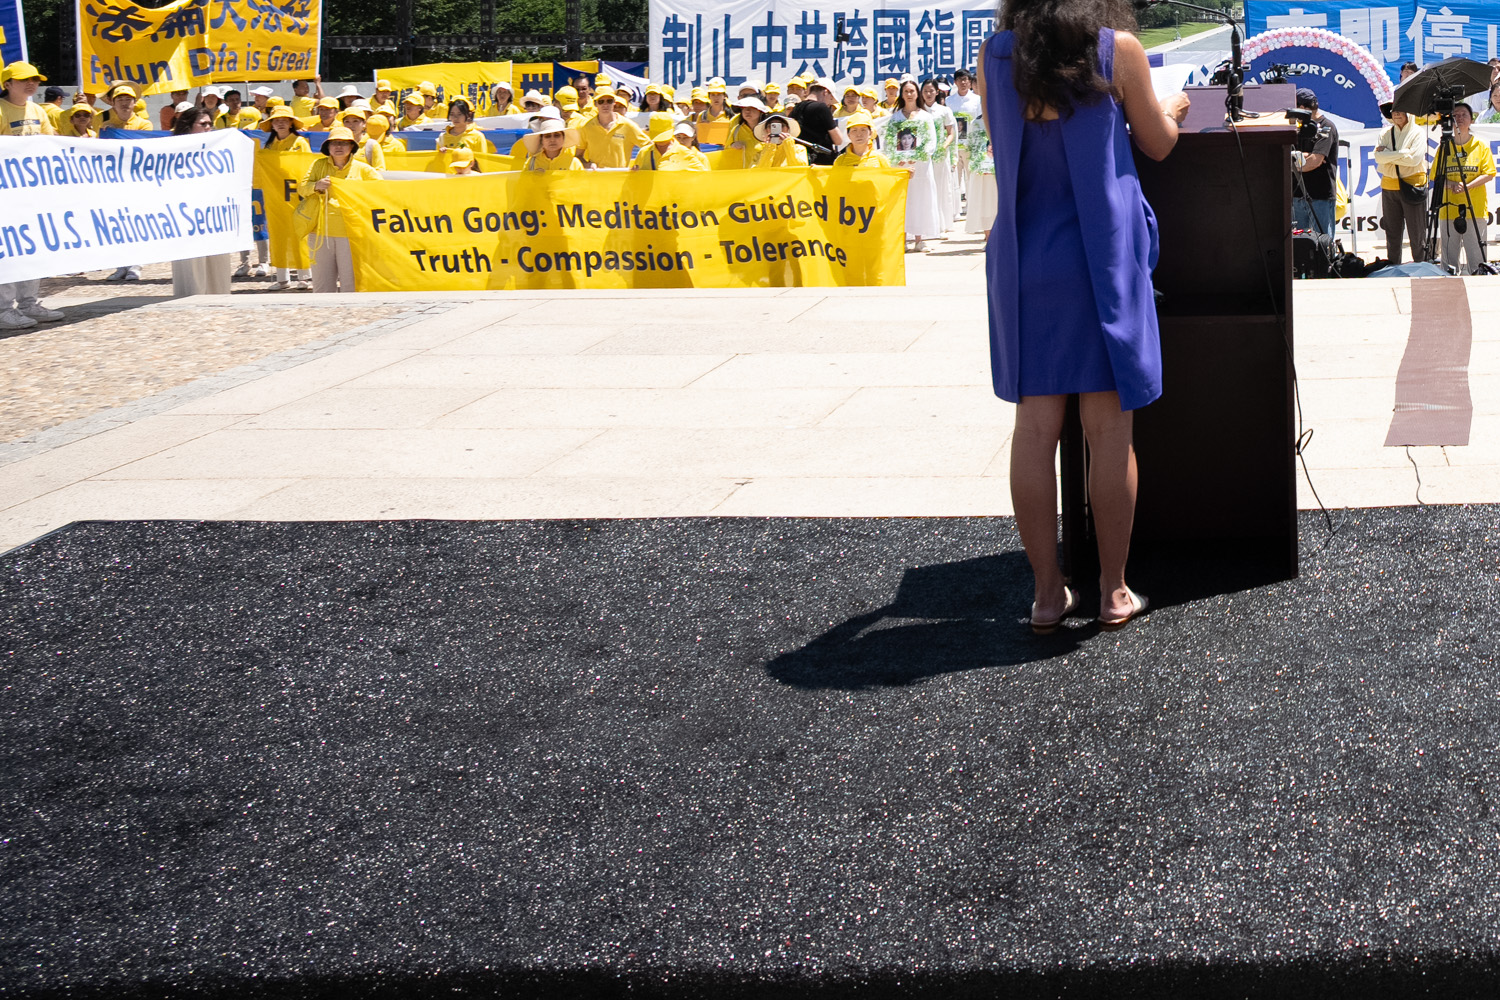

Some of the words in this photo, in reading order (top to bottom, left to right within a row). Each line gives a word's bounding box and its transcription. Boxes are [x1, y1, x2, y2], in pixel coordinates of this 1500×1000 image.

[90, 54, 173, 86] Falun
[245, 43, 260, 71] is
[267, 45, 312, 72] Great
[1334, 73, 1356, 89] OF
[130, 143, 235, 187] Repression
[37, 210, 91, 252] U.S.
[90, 203, 181, 247] National
[178, 196, 240, 237] Security
[371, 208, 453, 233] Falun
[463, 207, 547, 236] Gong:
[556, 201, 720, 230] Meditation
[728, 195, 828, 223] Guided
[838, 196, 876, 234] by
[410, 247, 492, 273] Truth
[517, 245, 694, 277] Compassion
[719, 236, 848, 268] Tolerance
